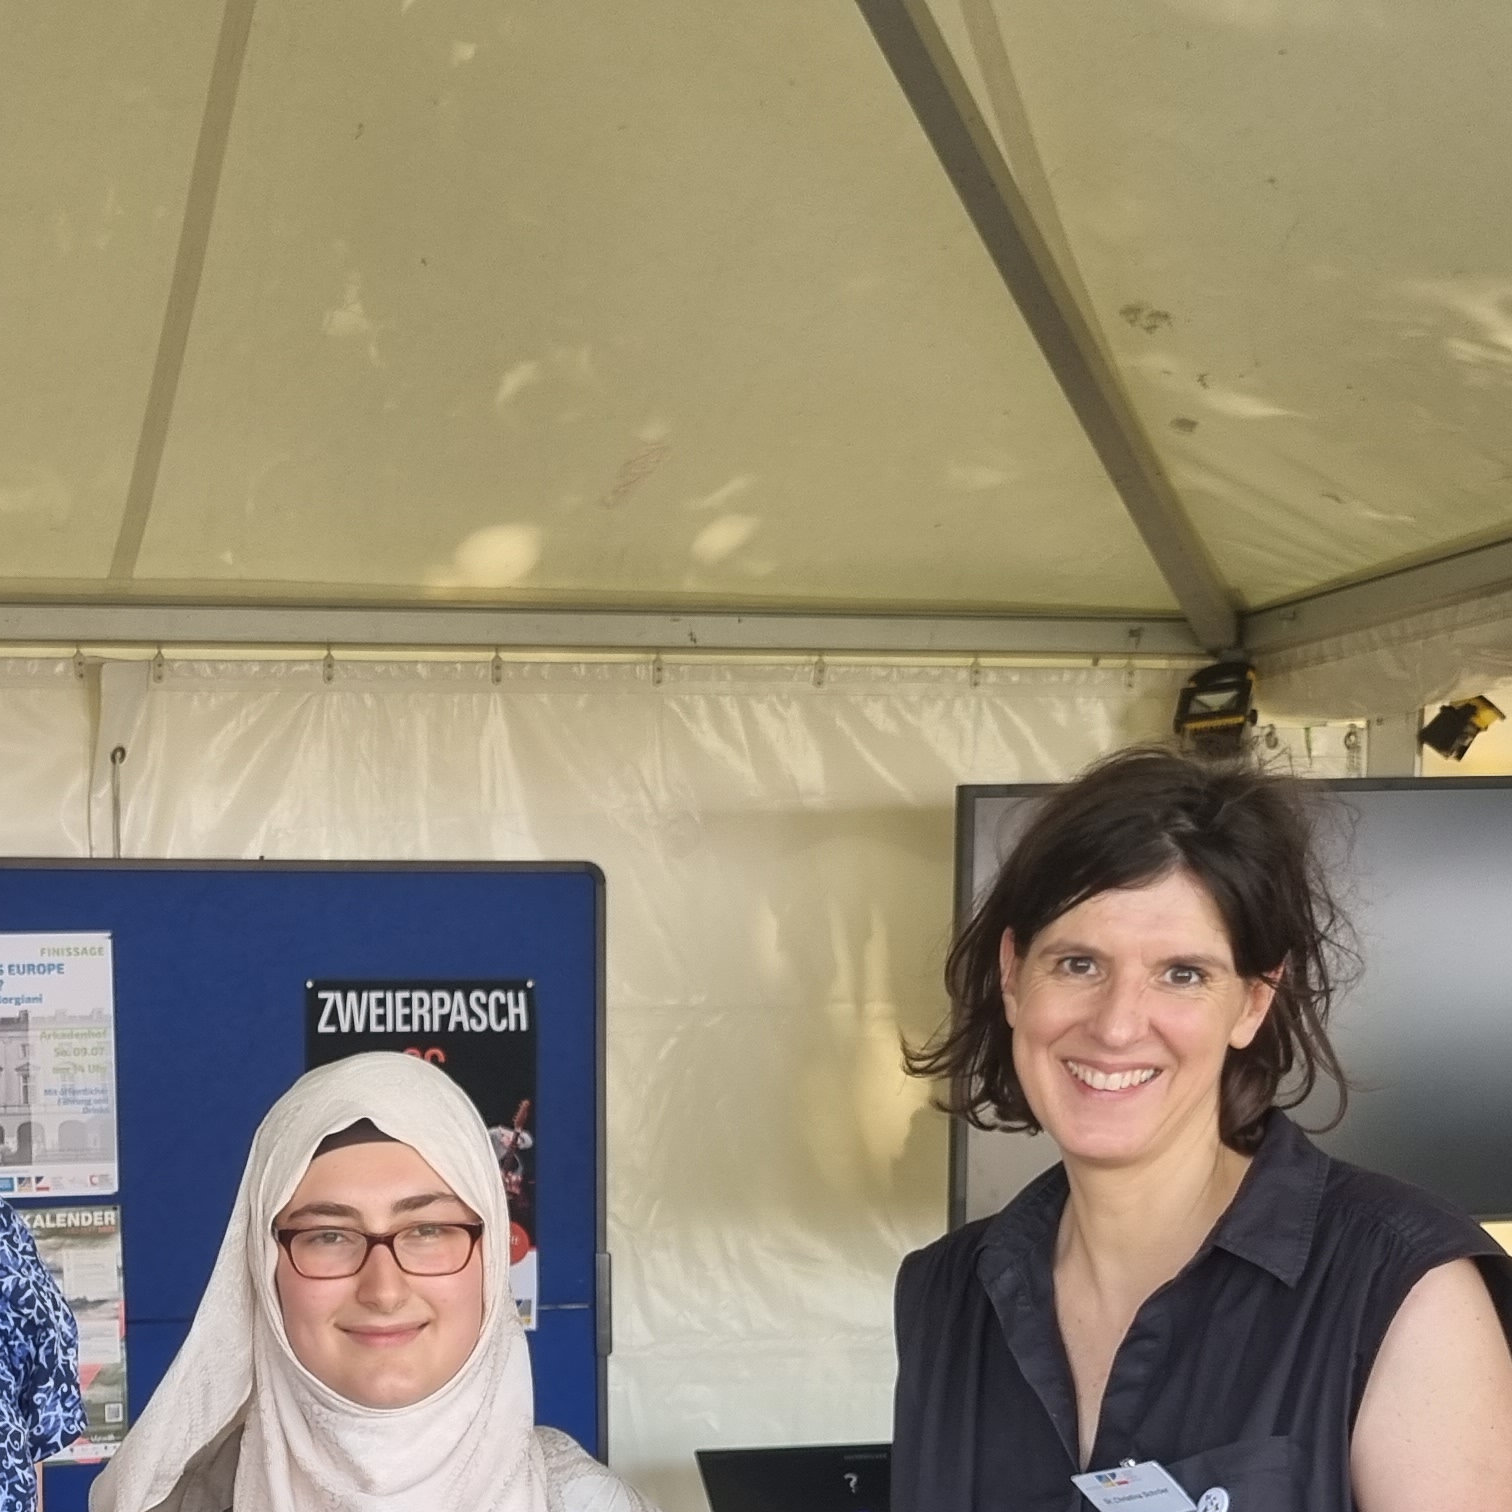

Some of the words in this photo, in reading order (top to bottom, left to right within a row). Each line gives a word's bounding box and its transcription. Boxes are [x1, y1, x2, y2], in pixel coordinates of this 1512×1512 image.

[40, 947, 105, 957] FINISSAGE
[8, 963, 65, 976] EUROPE
[317, 990, 529, 1033] ZWEIERPASCH
